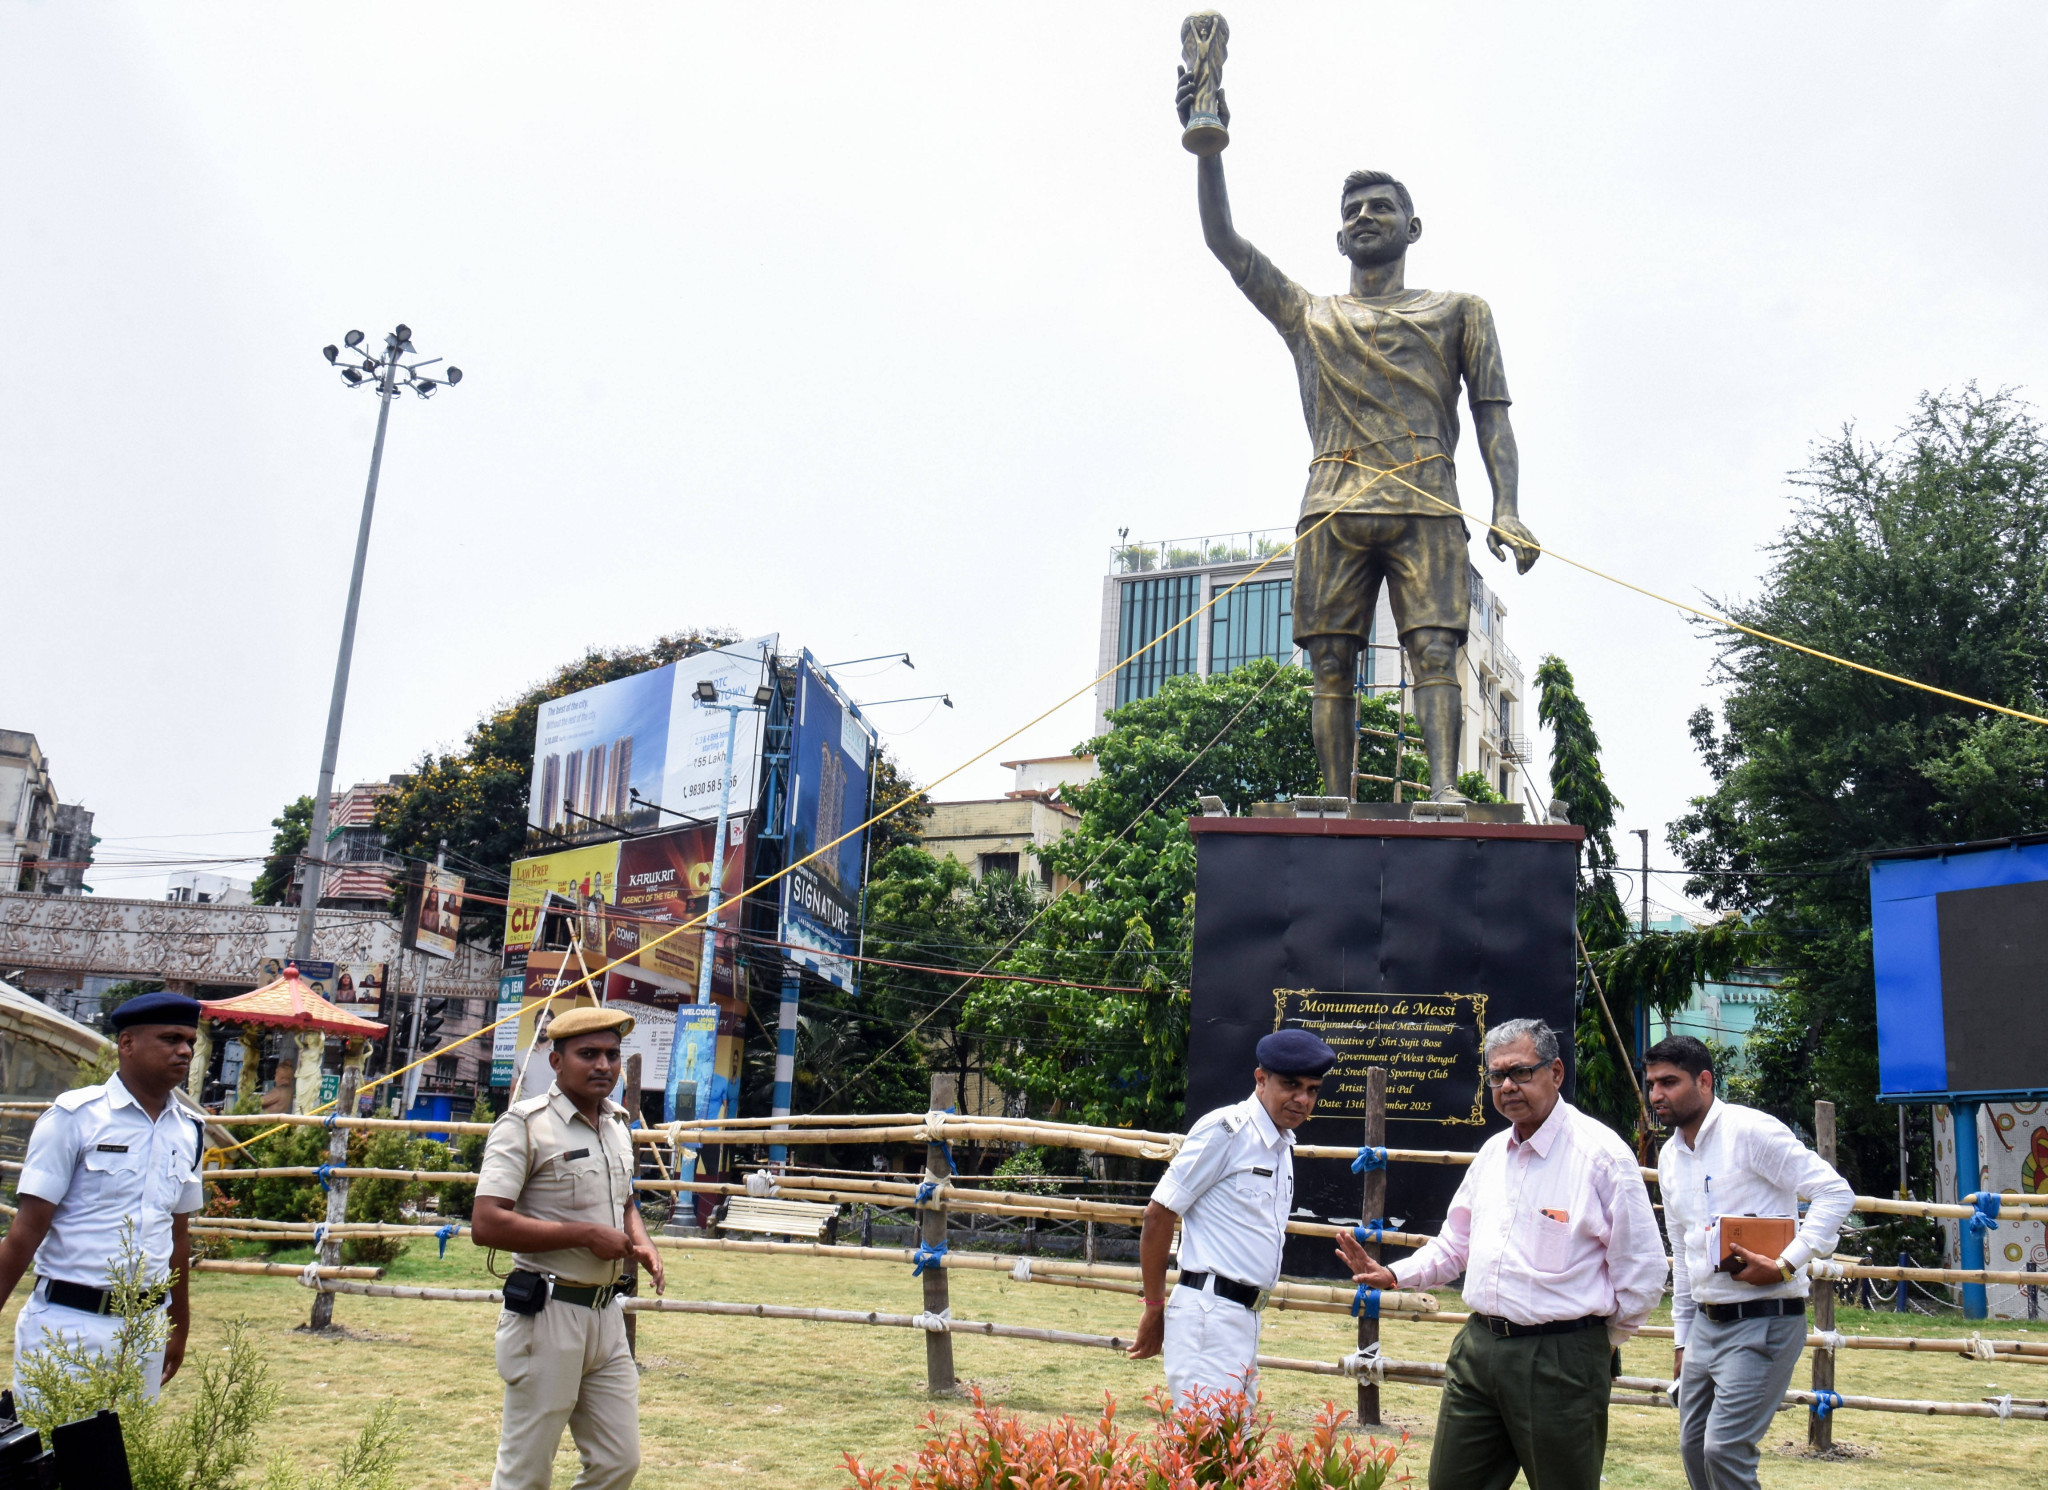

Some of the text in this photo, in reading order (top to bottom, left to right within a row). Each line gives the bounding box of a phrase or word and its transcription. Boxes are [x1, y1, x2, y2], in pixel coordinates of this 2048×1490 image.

[713, 677, 728, 688] DTC
[548, 707, 556, 716] The
[556, 705, 566, 715] best
[566, 703, 572, 712] of
[689, 784, 706, 797] 9830
[707, 780, 716, 793] 58
[629, 869, 676, 887] KARUKRIT
[646, 884, 658, 892] WINS
[622, 895, 645, 904] AGENCY
[646, 894, 653, 902] OF
[664, 890, 678, 900] YEAR
[794, 876, 849, 935] SIGNATURE
[511, 906, 540, 933] CLA
[616, 927, 638, 944] COMFY
[511, 980, 523, 993] IEM
[682, 1008, 716, 1016] WELCOME
[1299, 1000, 1456, 1016] Monumento de Messi
[688, 1022, 716, 1031] MESSI
[1302, 1020, 1455, 1034] Inaugurated by Lionel Messi himself
[1326, 1036, 1442, 1049] initiative of Shri Sujit Bose
[1337, 1052, 1458, 1067] Government of West Bengal
[1388, 1070, 1426, 1081] Sporting
[1428, 1069, 1448, 1079] Club
[1336, 1083, 1365, 1093] Artist:
[1397, 1084, 1414, 1094] Pal
[1318, 1099, 1342, 1108] Date:
[1345, 1100, 1365, 1108] 13th
[1410, 1102, 1432, 1110] 2025
